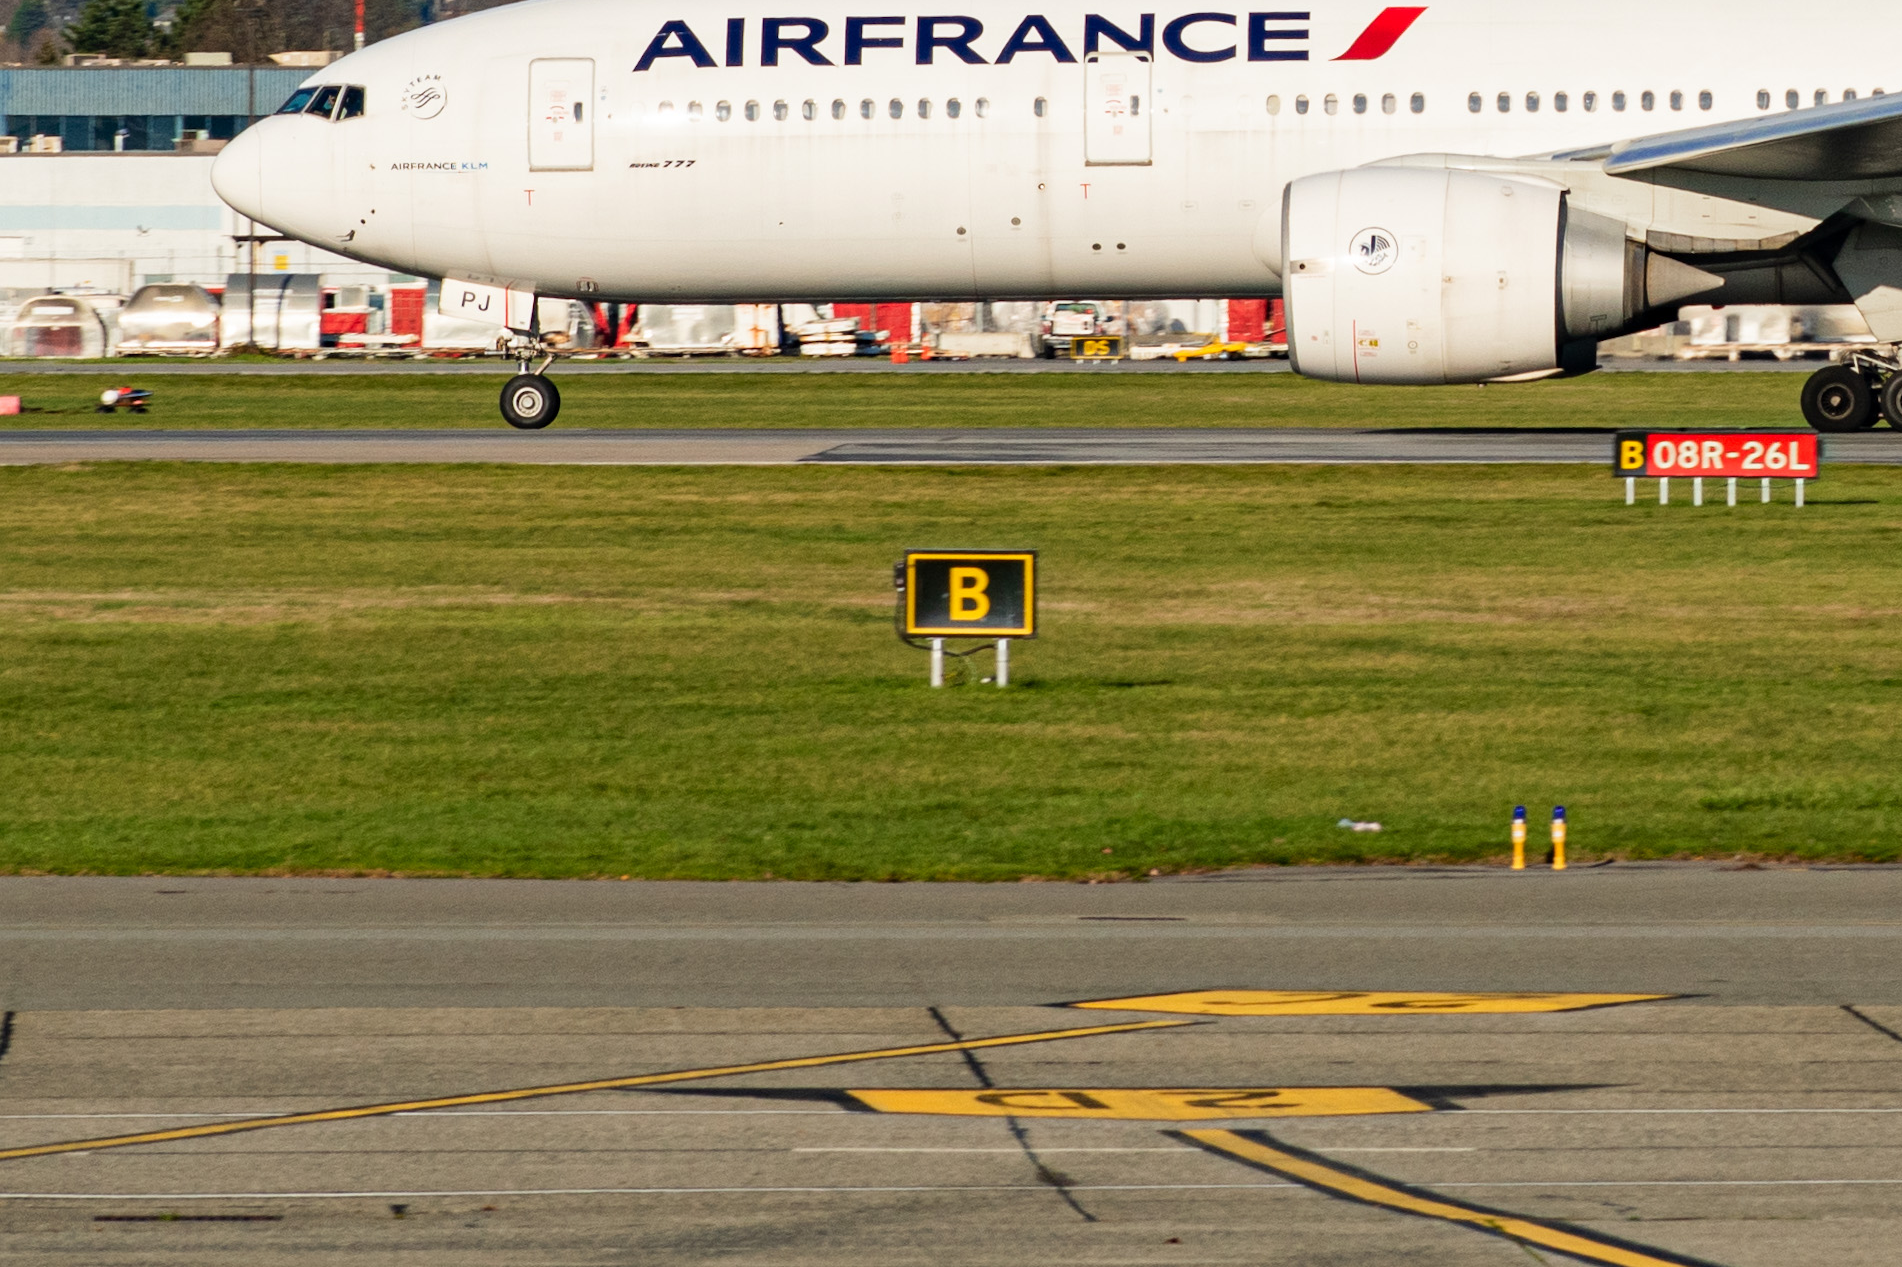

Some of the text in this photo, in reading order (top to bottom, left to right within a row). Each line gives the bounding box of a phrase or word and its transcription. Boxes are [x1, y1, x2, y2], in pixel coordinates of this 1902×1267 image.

[632, 11, 1311, 73] AIRFRANCE
[390, 162, 488, 171] AIRFRANCE KLM
[663, 160, 696, 168] 777
[461, 290, 491, 312] PJ
[1620, 440, 1812, 471] B 08R-26L
[949, 566, 991, 622] B
